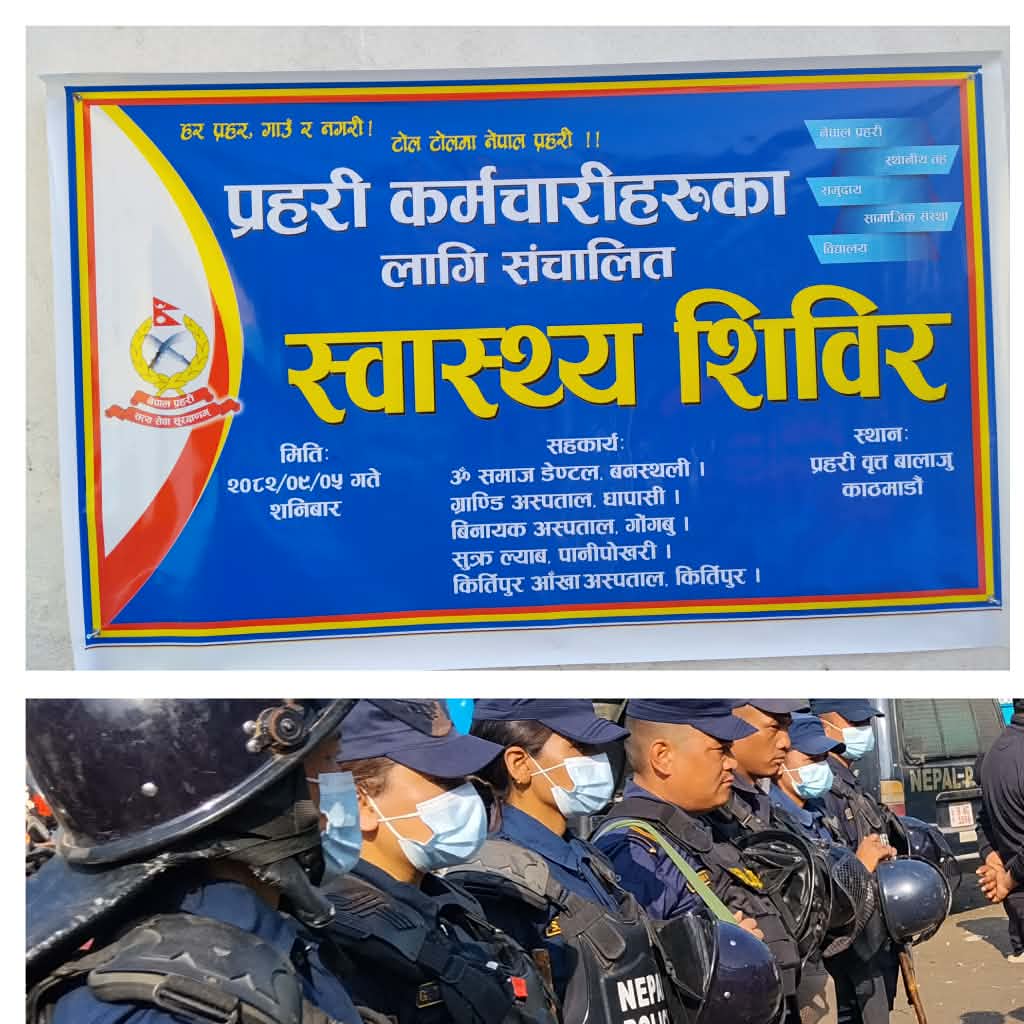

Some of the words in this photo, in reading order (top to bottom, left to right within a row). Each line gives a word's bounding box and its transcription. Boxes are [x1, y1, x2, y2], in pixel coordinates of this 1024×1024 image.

[180, 122, 205, 141] हर
[213, 122, 253, 142] प्रहर,
[261, 118, 293, 139] गाउँ
[300, 121, 313, 139] र
[391, 130, 421, 153] टोल
[429, 130, 477, 153] टोलमा
[484, 129, 526, 151] नेपाल
[533, 126, 573, 153] प्रहरी
[855, 124, 883, 138] प्रहरी
[223, 166, 372, 239] प्रहरी
[821, 185, 863, 198] समुदाय
[864, 210, 916, 225] सामाजिक
[823, 241, 868, 256] विद्यालय
[379, 241, 489, 288] लागि
[501, 236, 676, 286] संचालित
[284, 322, 643, 424] स्वास्थ्य
[673, 284, 952, 410] शिविर
[478, 467, 535, 485] समाज
[609, 457, 690, 480] बनस्थली
[810, 451, 857, 474] प्रहरी
[861, 454, 889, 475] वृत्त
[894, 452, 955, 472] बालाजु
[227, 472, 343, 494] २०८२/०९/०५
[350, 467, 382, 489] गते
[270, 497, 342, 521] शनिबार
[450, 491, 505, 515] ग्राण्डि
[451, 519, 527, 540] बिनायक
[451, 550, 493, 571] सुक्र
[558, 539, 657, 563] पानीपोखरी
[452, 572, 525, 597] किर्तिपुर
[675, 564, 746, 589] किर्तिपुर
[616, 973, 665, 1013] NEPA
